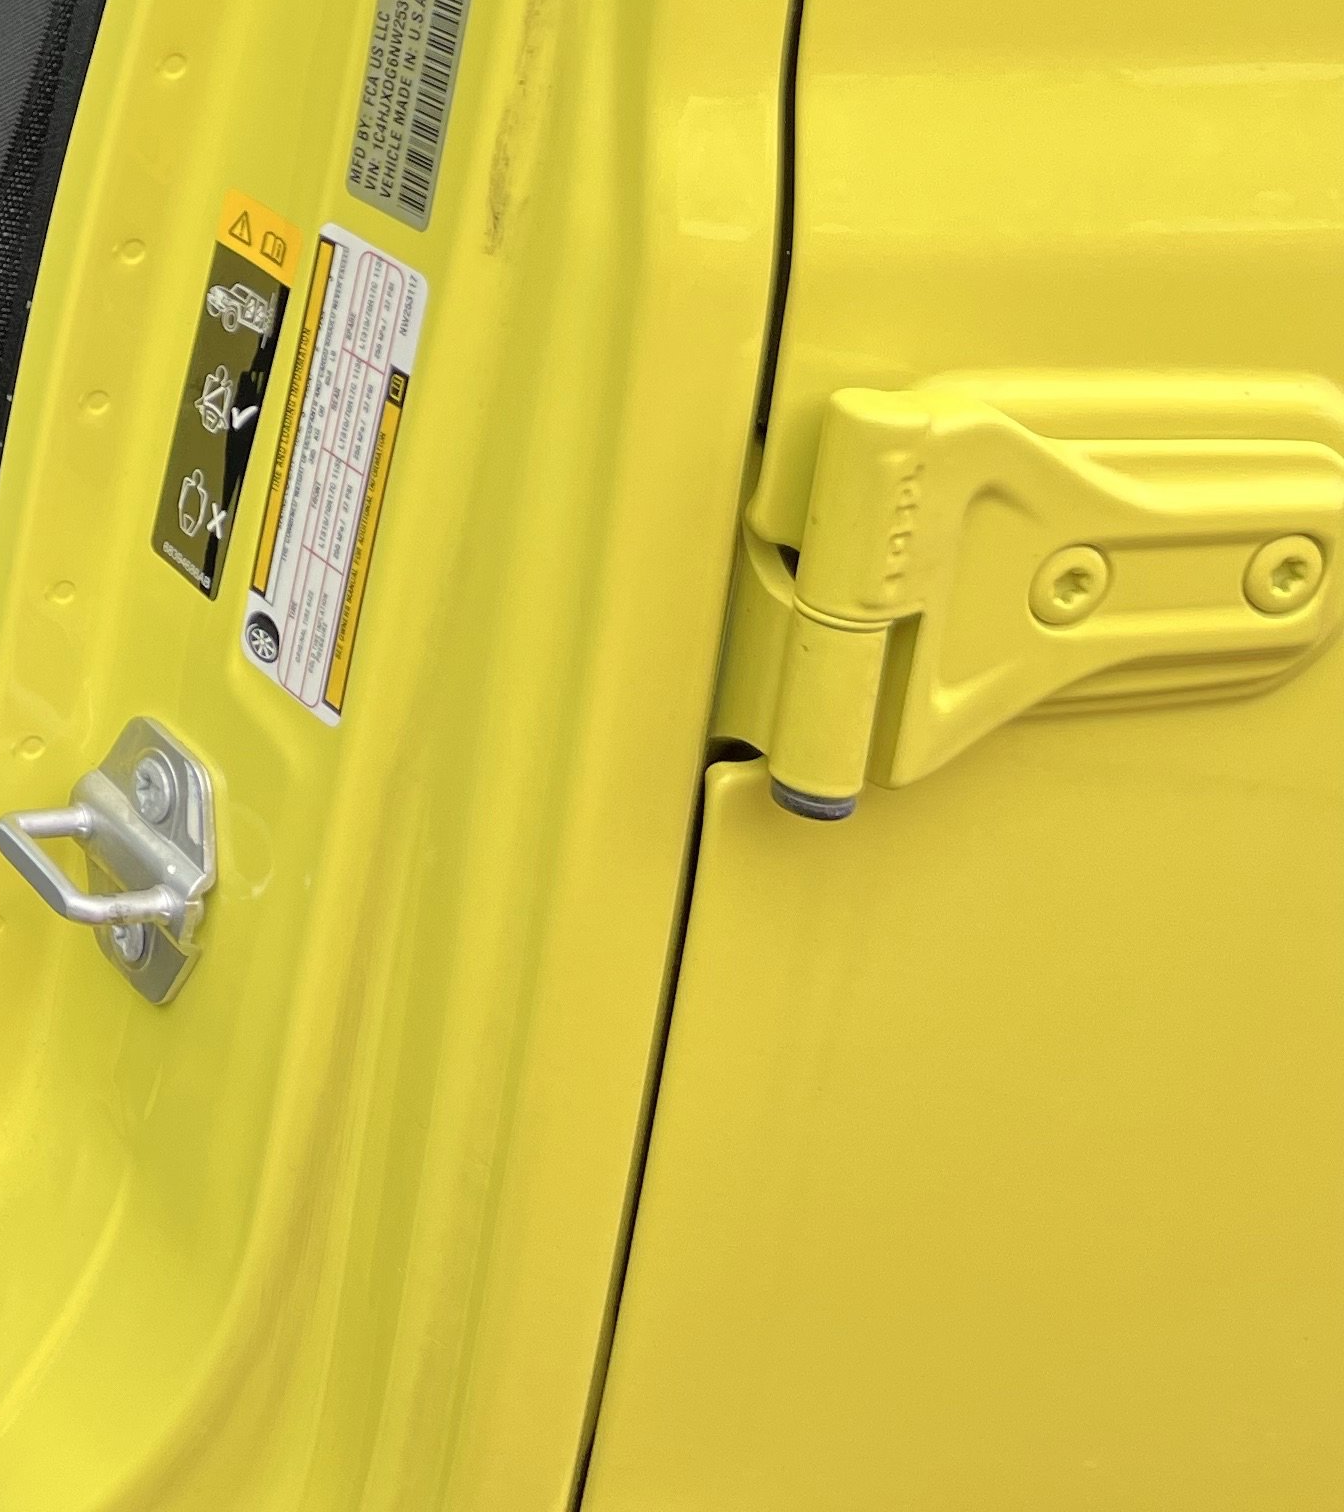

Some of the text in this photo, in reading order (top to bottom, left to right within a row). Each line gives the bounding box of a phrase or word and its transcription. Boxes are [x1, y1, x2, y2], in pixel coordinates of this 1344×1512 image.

[401, 44, 418, 72] IN:
[350, 9, 390, 185] MFD BY: FCA US LLC
[392, 74, 413, 126] MADE
[364, 156, 383, 193] VIN:
[380, 129, 404, 201] VEHICLE
[398, 273, 418, 337] NW253117
